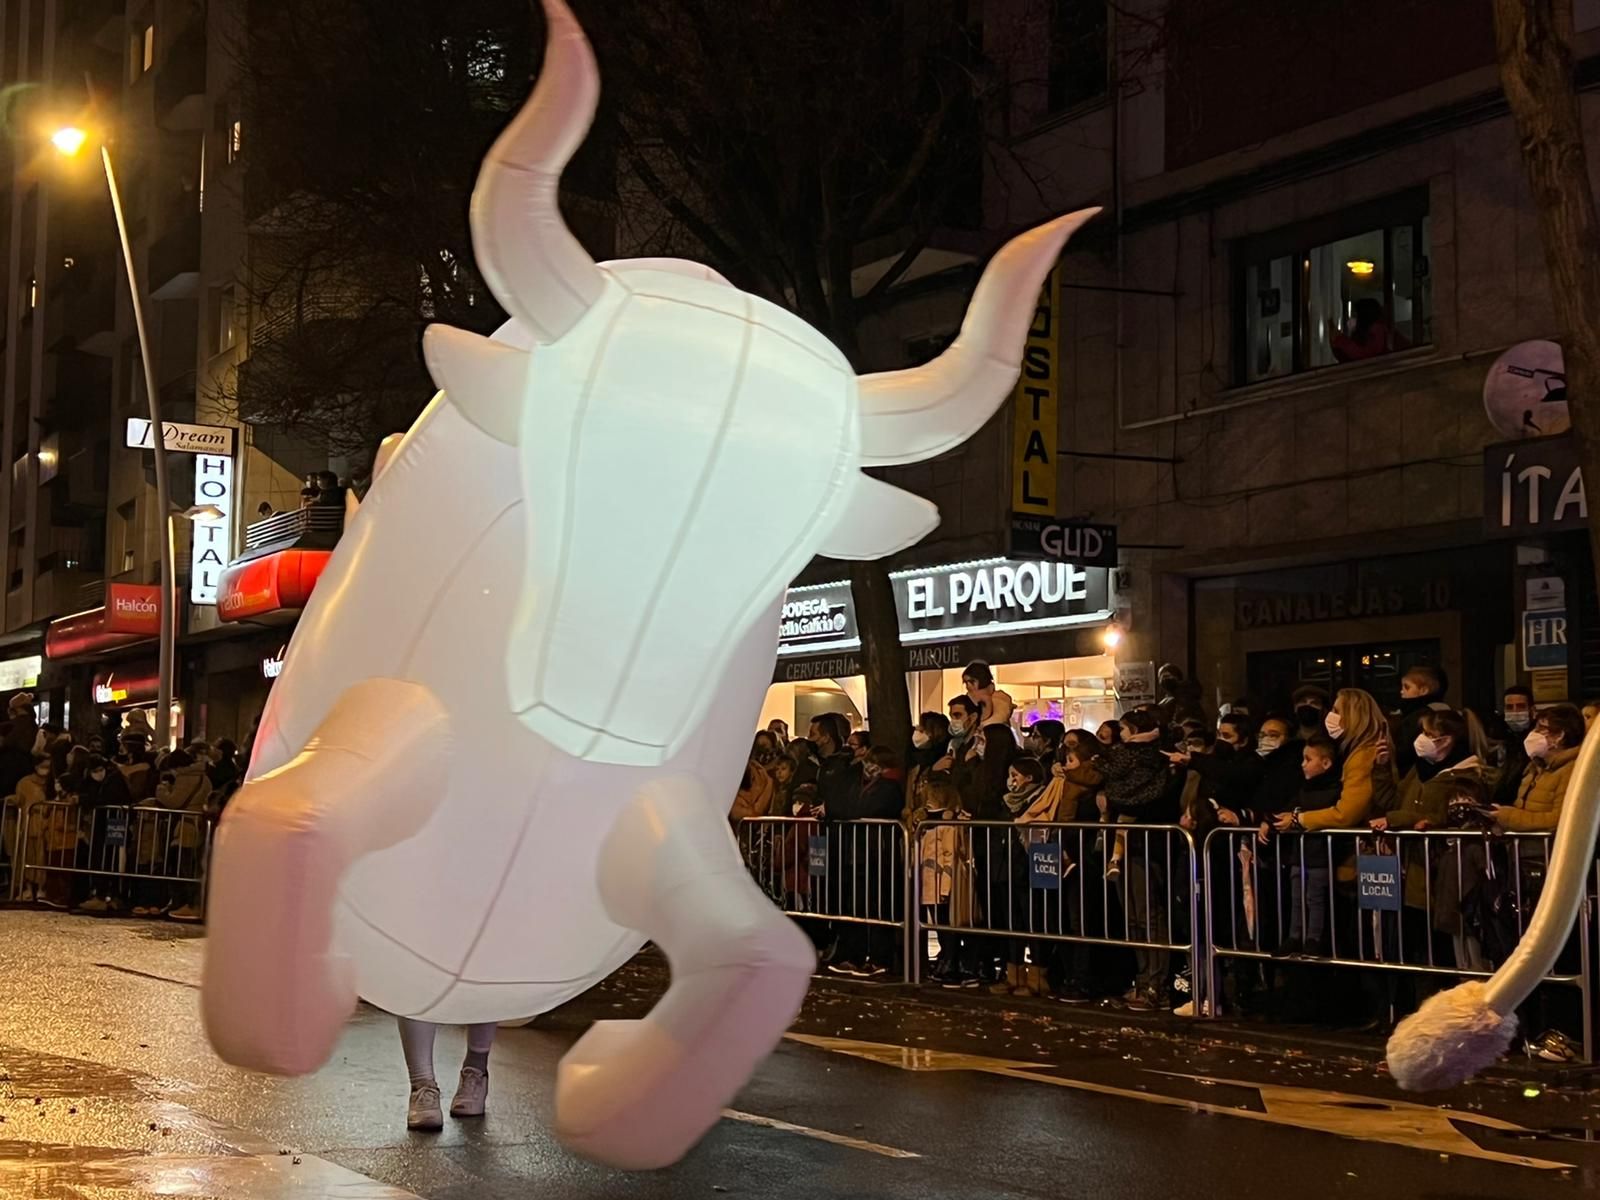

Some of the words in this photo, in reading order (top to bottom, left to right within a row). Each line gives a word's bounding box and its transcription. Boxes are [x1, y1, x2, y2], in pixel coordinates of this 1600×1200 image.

[1023, 266, 1052, 506] OSTAL
[162, 424, 226, 445] Dream
[174, 442, 226, 453] Salamanca
[196, 458, 226, 588] HOTAL
[1040, 525, 1103, 559] GUD
[907, 577, 945, 619] EL
[949, 561, 1087, 612] PARQUE
[1238, 582, 1404, 624] CANALEJAS
[1424, 577, 1453, 609] 10
[799, 616, 834, 634] Galicia
[786, 654, 856, 680] CERVECERÍA
[909, 645, 961, 668] PARQUE
[1362, 886, 1393, 897] LOCAL
